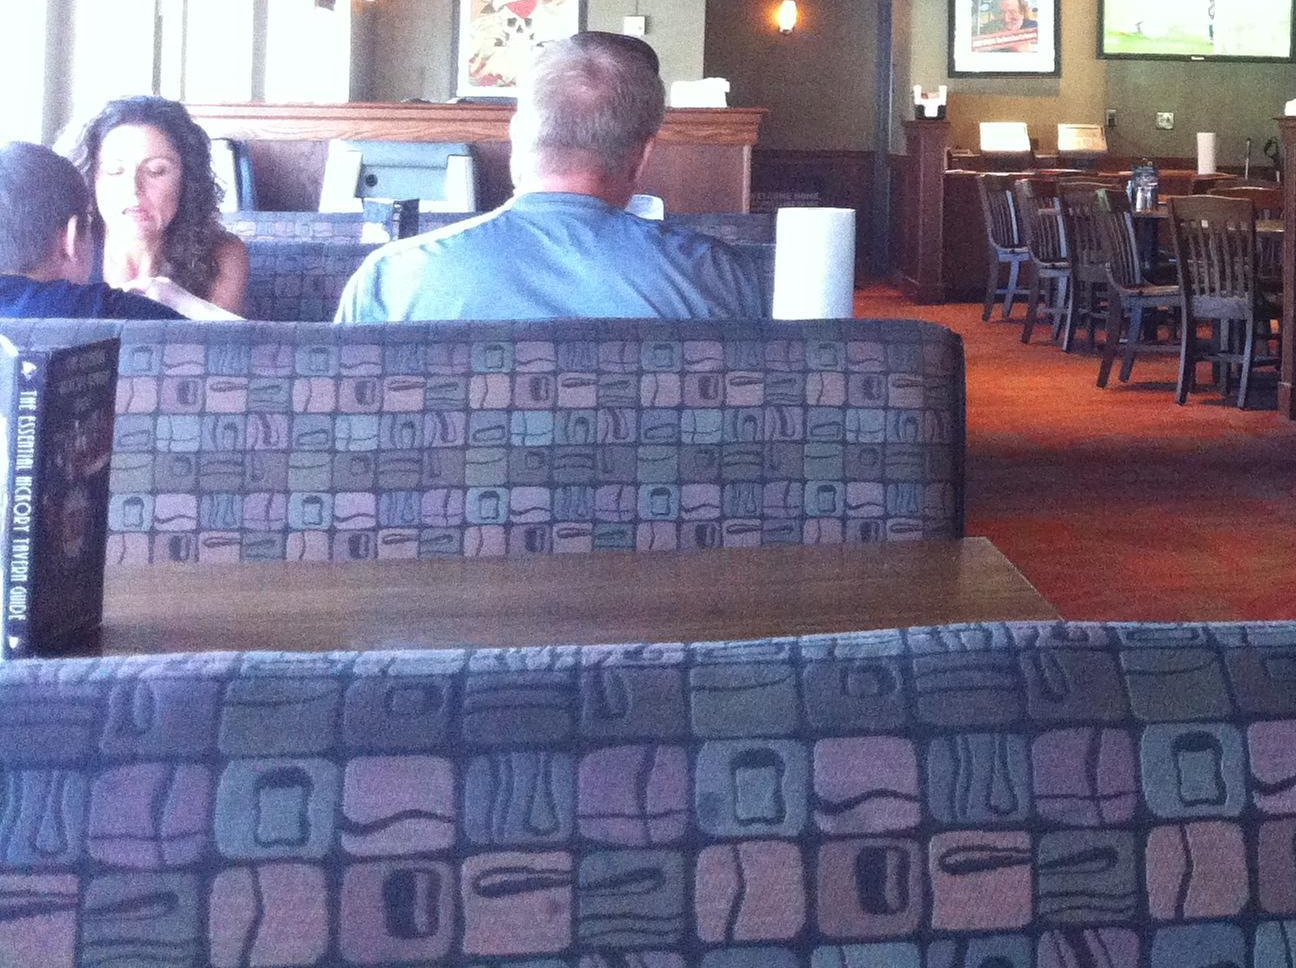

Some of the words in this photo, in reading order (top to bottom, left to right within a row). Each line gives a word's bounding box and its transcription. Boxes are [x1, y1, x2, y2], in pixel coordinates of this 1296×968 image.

[18, 390, 38, 411] THE
[15, 416, 37, 471] ESSENTIAL
[12, 476, 34, 532] HICKORY
[10, 538, 31, 582] TAVERN
[8, 586, 28, 621] GUIDE
